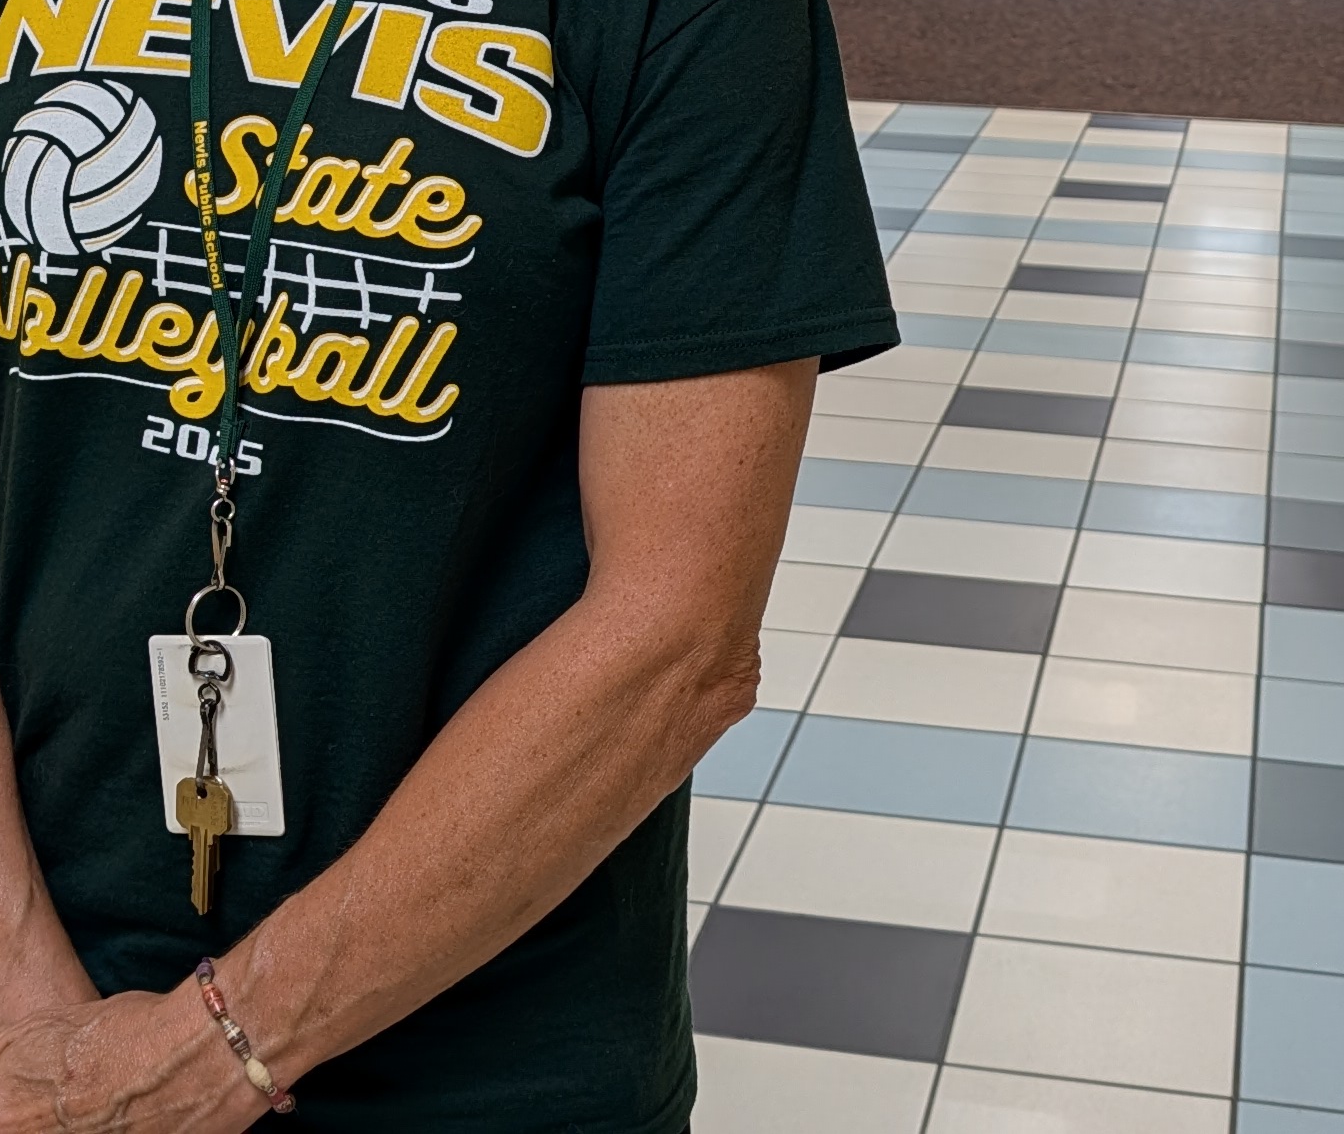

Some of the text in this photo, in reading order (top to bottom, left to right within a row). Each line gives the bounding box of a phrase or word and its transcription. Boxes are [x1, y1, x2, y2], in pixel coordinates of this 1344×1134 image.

[193, 120, 225, 290] Nevis Public School
